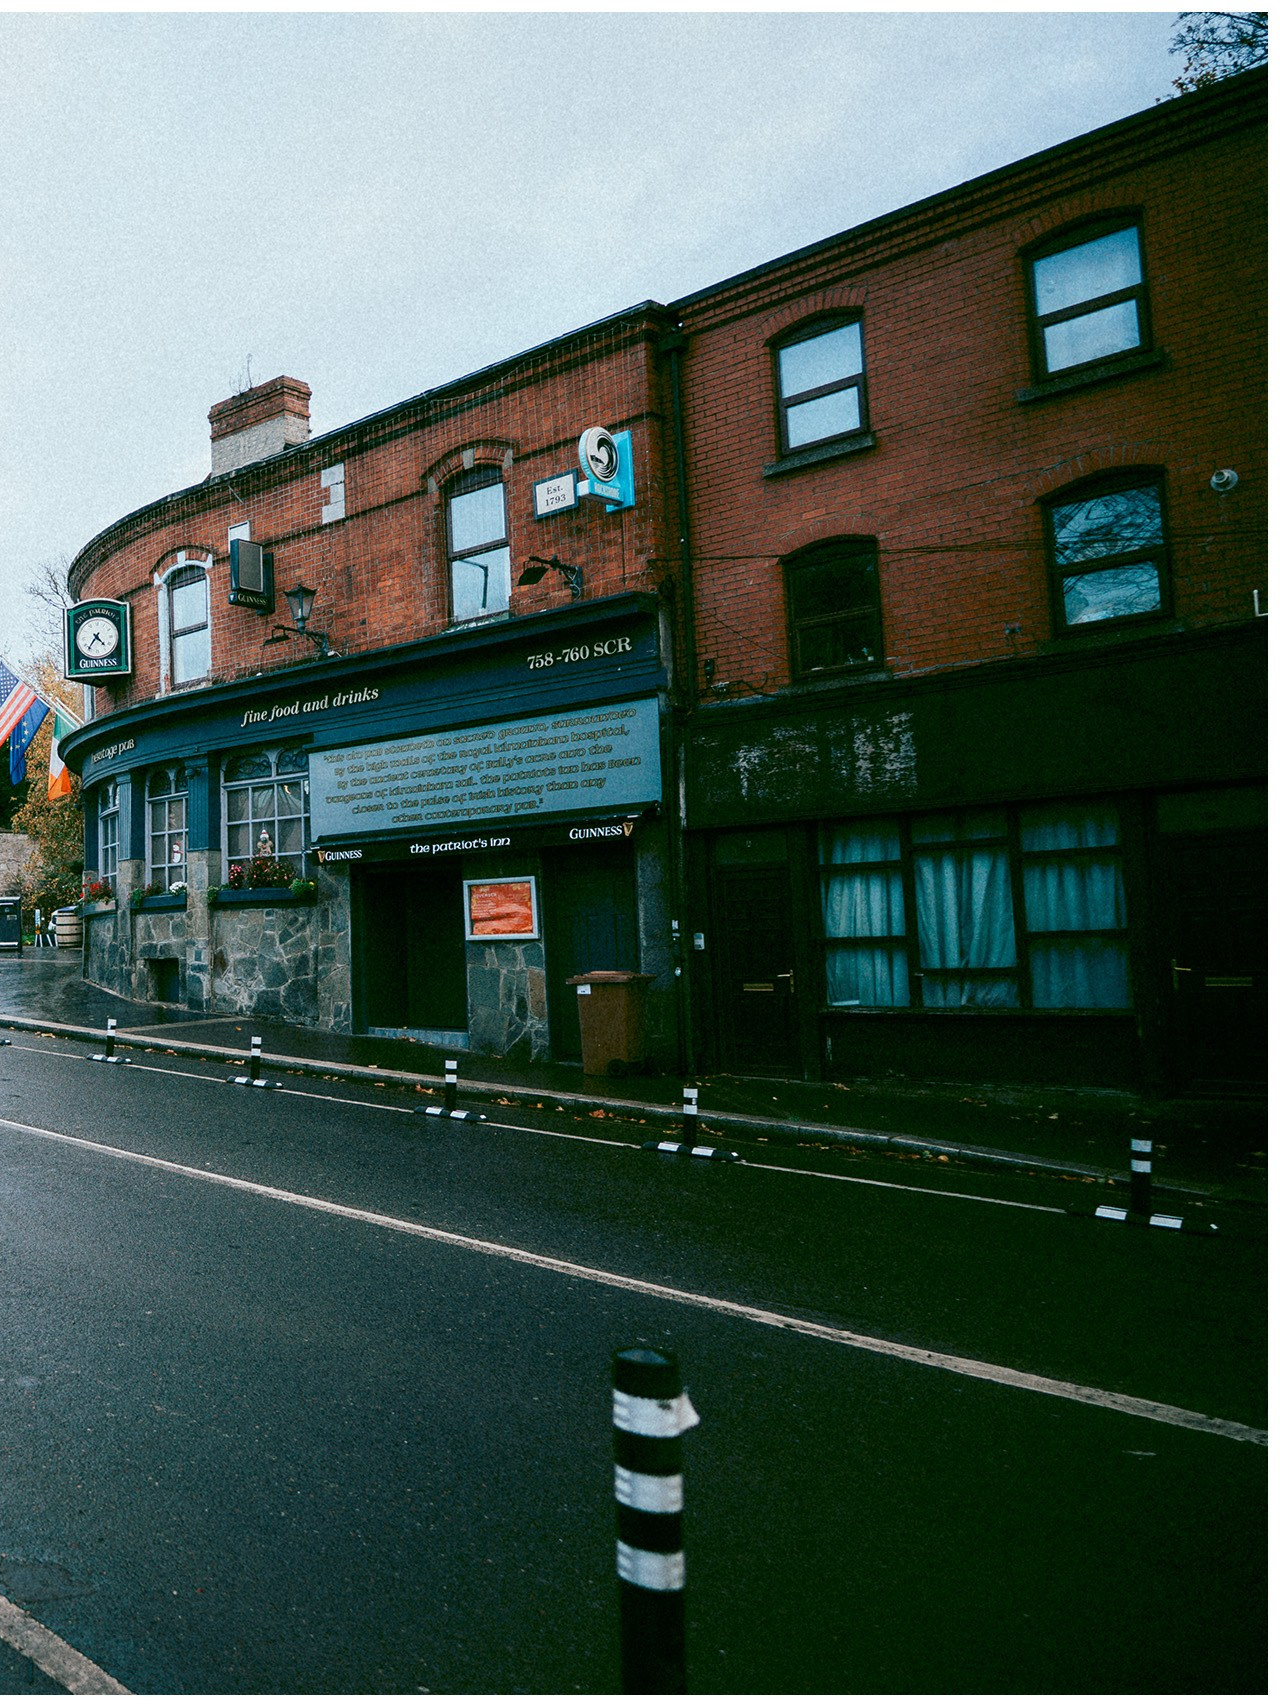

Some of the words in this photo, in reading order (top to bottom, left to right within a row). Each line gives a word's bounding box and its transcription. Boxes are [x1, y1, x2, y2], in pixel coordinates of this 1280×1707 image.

[546, 485, 564, 495] Est.
[545, 494, 567, 507] 1793
[593, 636, 632, 658] SCR
[79, 658, 117, 669] GUINNESS
[240, 709, 268, 727] fine
[268, 701, 300, 722] food
[302, 696, 330, 713] and
[332, 687, 379, 706] drinks
[569, 826, 623, 840] GUINNESS
[410, 843, 430, 855] the
[325, 850, 363, 862] GUINNESS
